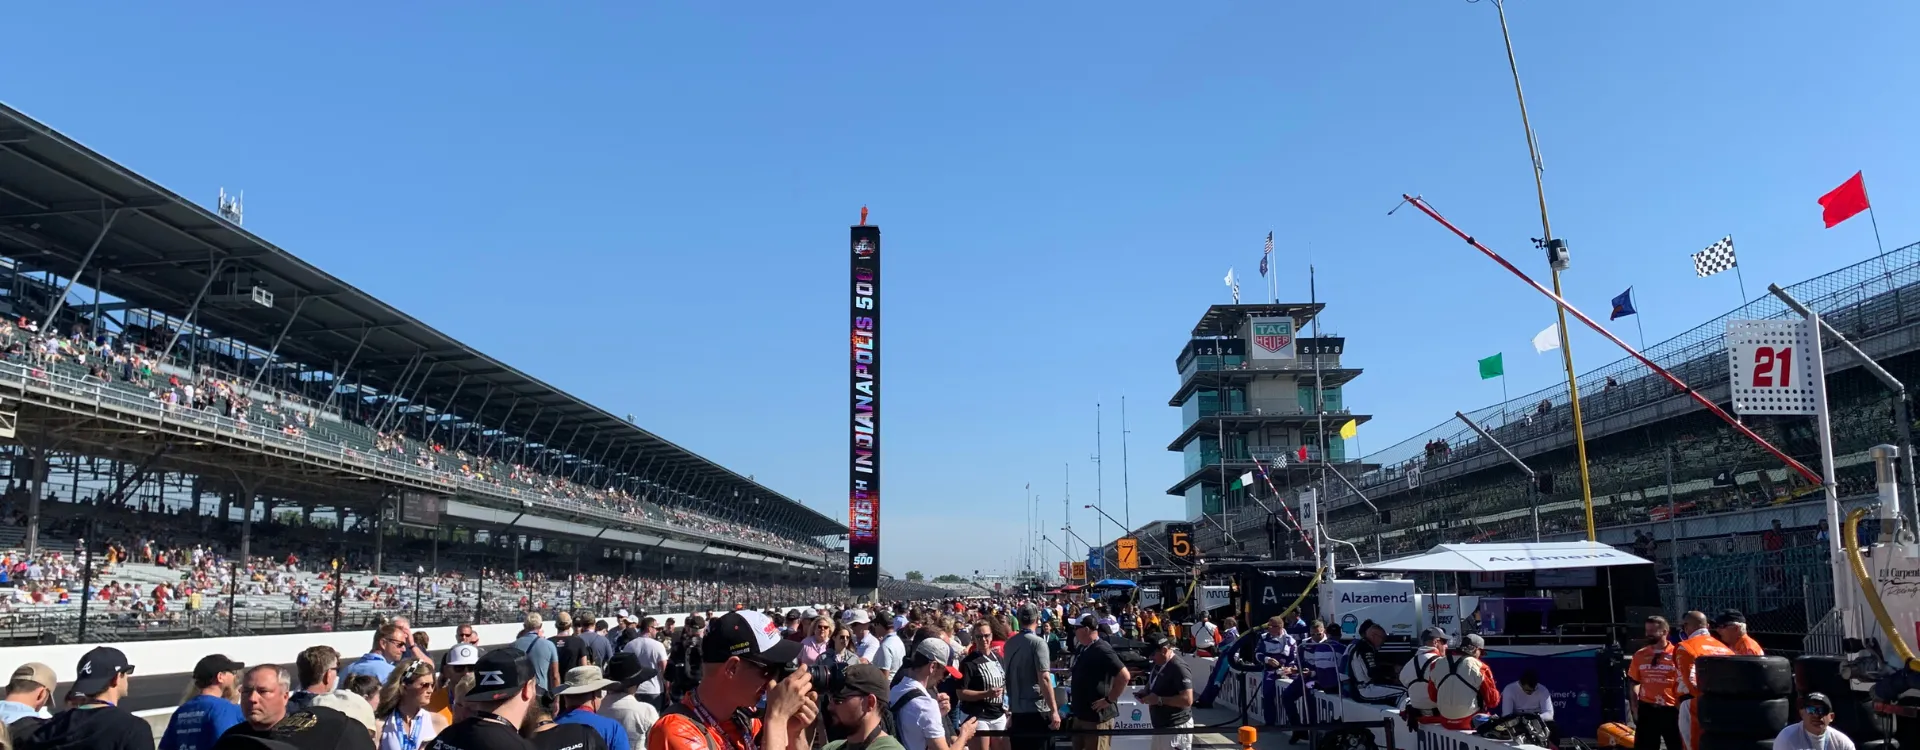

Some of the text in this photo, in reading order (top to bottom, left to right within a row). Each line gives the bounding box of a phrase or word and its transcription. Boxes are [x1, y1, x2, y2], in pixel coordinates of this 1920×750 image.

[1257, 325, 1288, 335] TAG
[1255, 335, 1290, 351] HEUER
[1207, 347, 1213, 355] 2
[1227, 347, 1233, 355] 4
[1304, 346, 1310, 354] 5
[1324, 346, 1330, 354] 7
[1752, 346, 1792, 387] 21
[854, 316, 873, 474] INDIANAPOLIS
[1303, 502, 1311, 519] 33
[1172, 532, 1190, 557] 5
[1121, 545, 1134, 563] 7
[1489, 552, 1616, 562] Alzamend
[853, 556, 873, 565] 500
[1341, 592, 1408, 603] Alzamend
[1114, 721, 1152, 729] Alzamen
